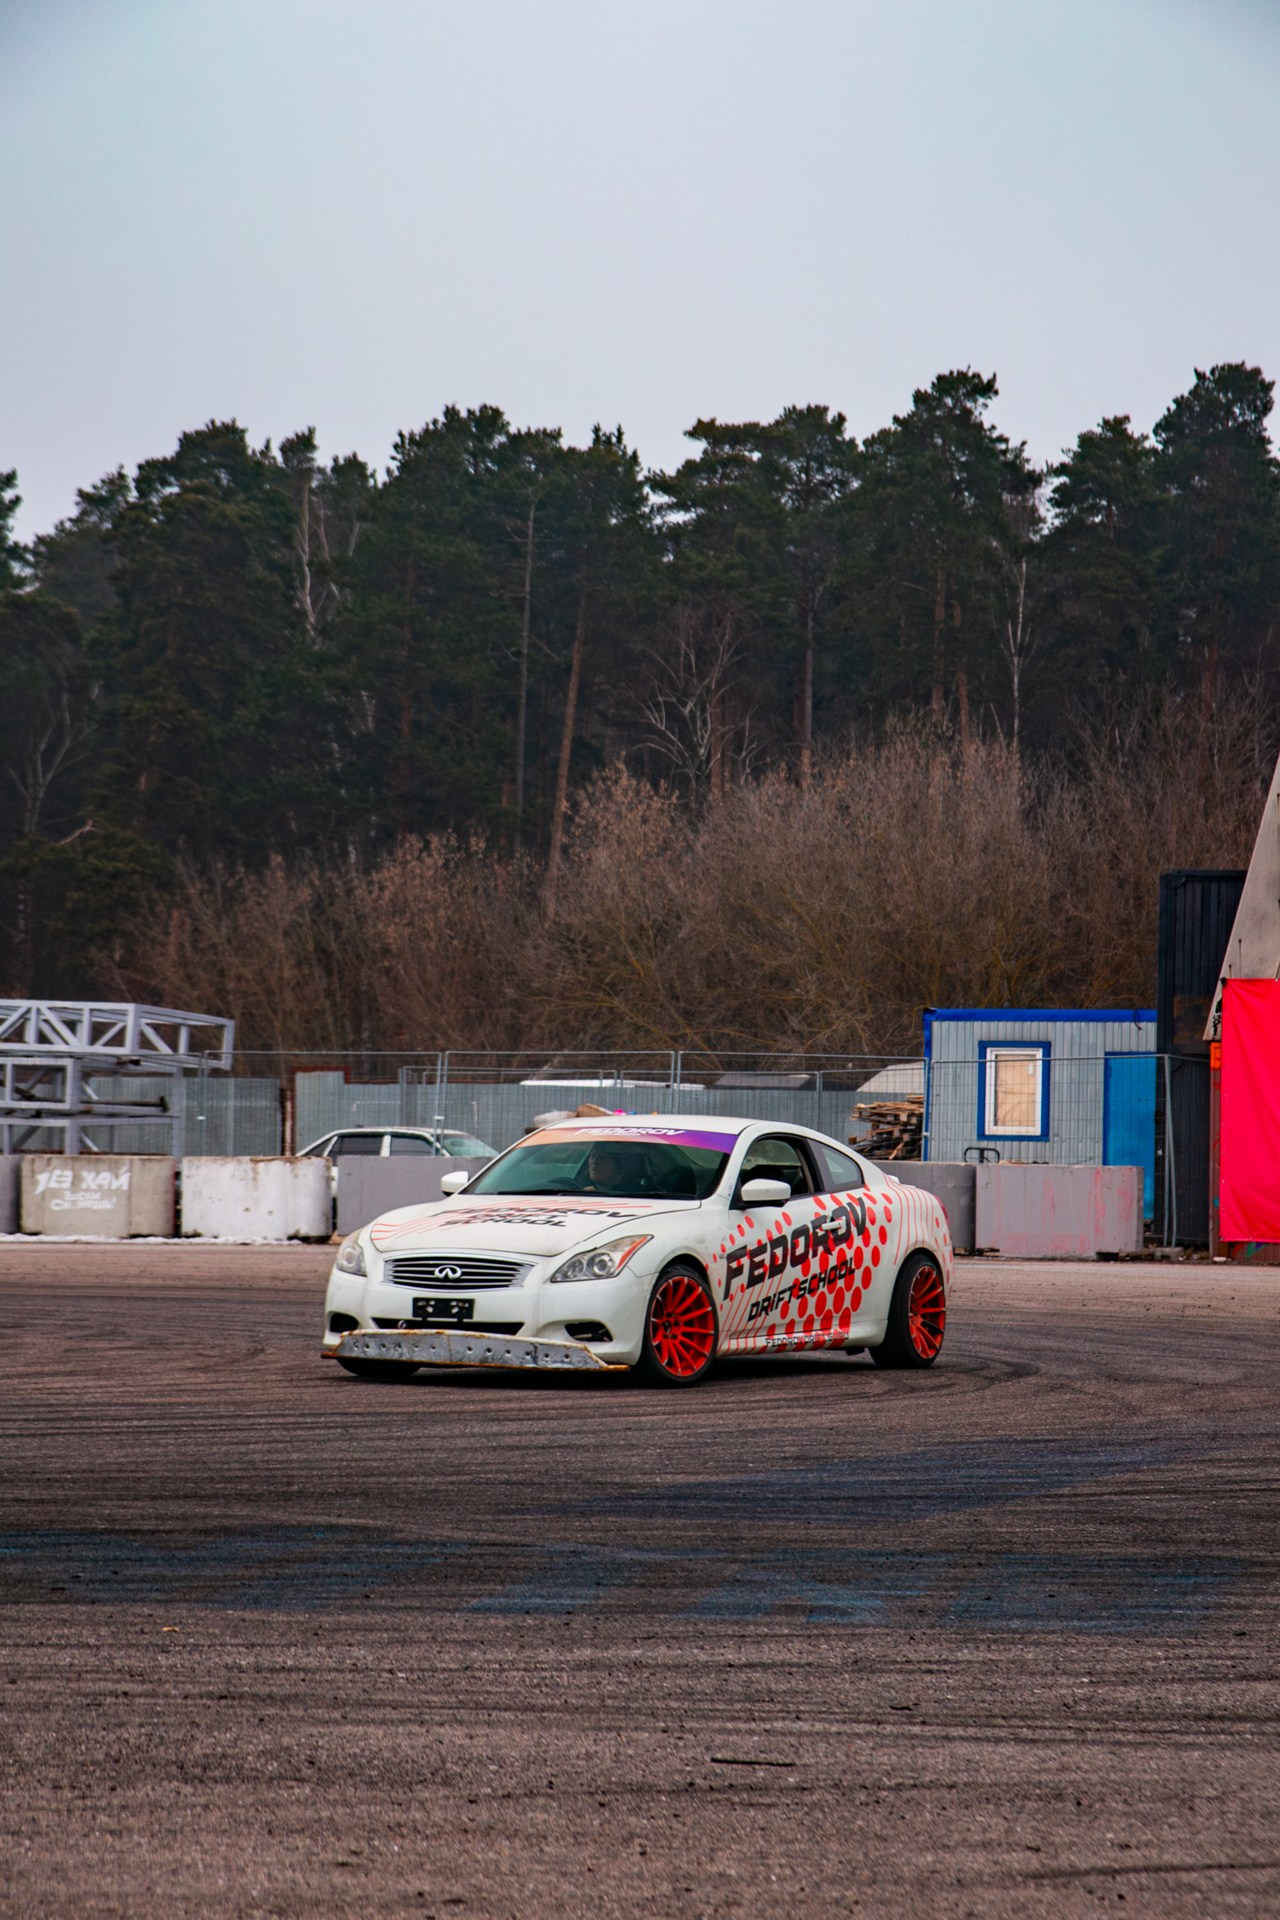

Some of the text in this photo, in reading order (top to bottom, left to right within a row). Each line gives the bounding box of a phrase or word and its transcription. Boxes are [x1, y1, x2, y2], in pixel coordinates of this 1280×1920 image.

[429, 1207, 642, 1218] FEDOROV
[439, 1218, 566, 1227] SCHOOL
[723, 1197, 866, 1301] FEDOROV
